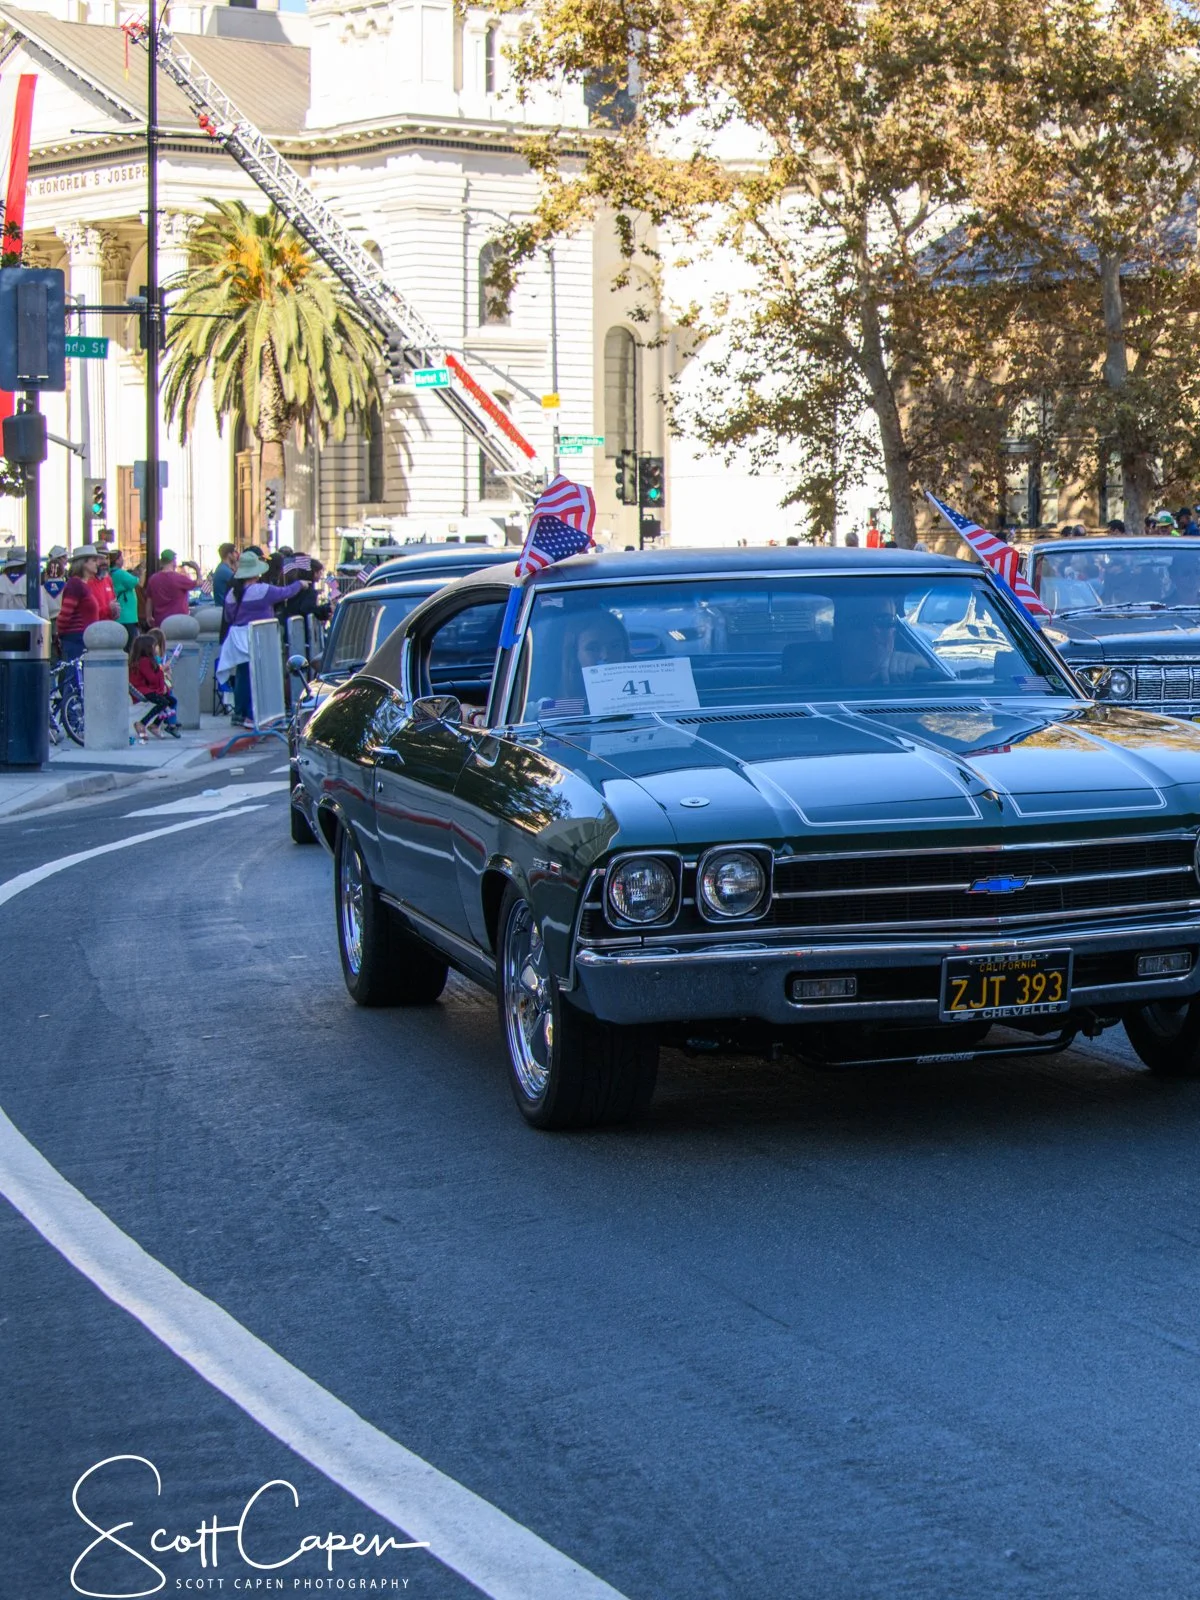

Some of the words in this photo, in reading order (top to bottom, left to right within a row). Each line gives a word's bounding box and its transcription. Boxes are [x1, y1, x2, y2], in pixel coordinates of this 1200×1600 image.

[92, 341, 105, 354] St
[622, 680, 655, 695] 41
[979, 959, 1037, 972] CALIFORNIA
[951, 975, 1006, 1011] ZJT
[1016, 971, 1062, 1005] 393
[982, 1003, 1058, 1018] CHEVELLE
